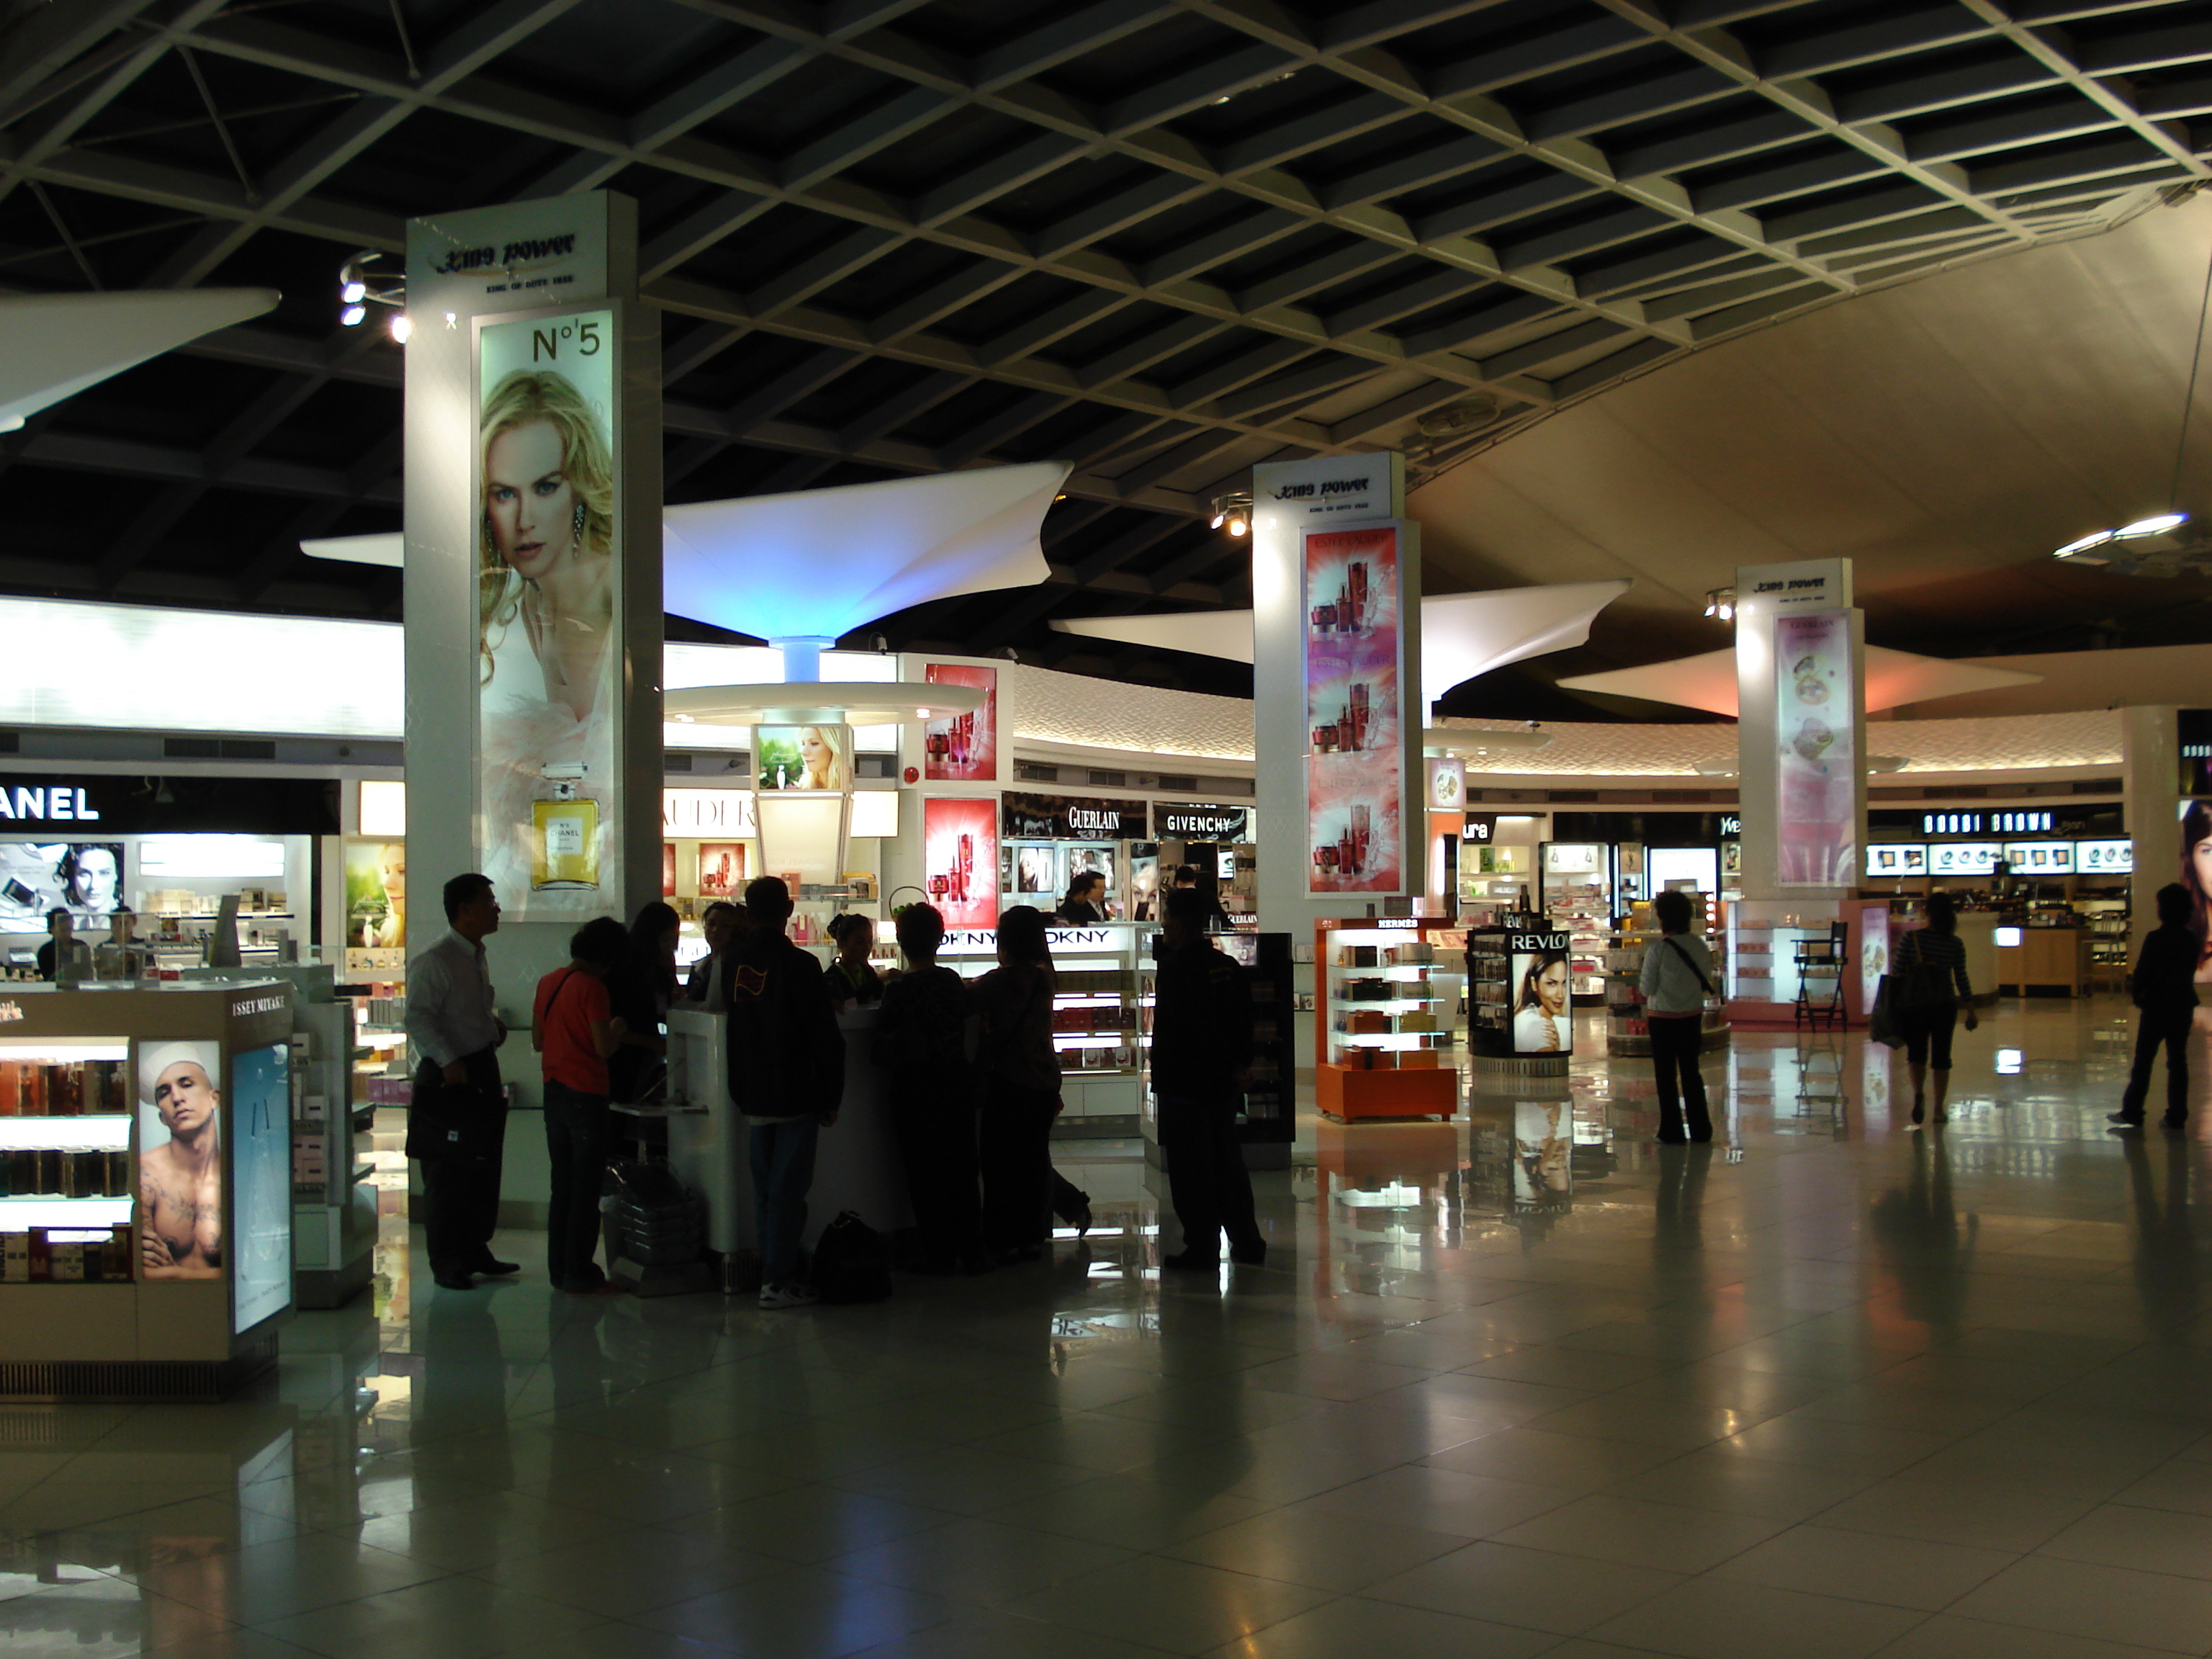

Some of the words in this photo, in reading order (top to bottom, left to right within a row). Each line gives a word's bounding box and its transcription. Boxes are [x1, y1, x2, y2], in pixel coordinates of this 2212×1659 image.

[1069, 806, 1120, 830] GUERLAIN
[1167, 815, 1231, 832] GIVENCHY
[1924, 814, 1979, 833] BOBBI
[1991, 812, 2051, 832] BROWN
[1045, 930, 1110, 944] DKNY
